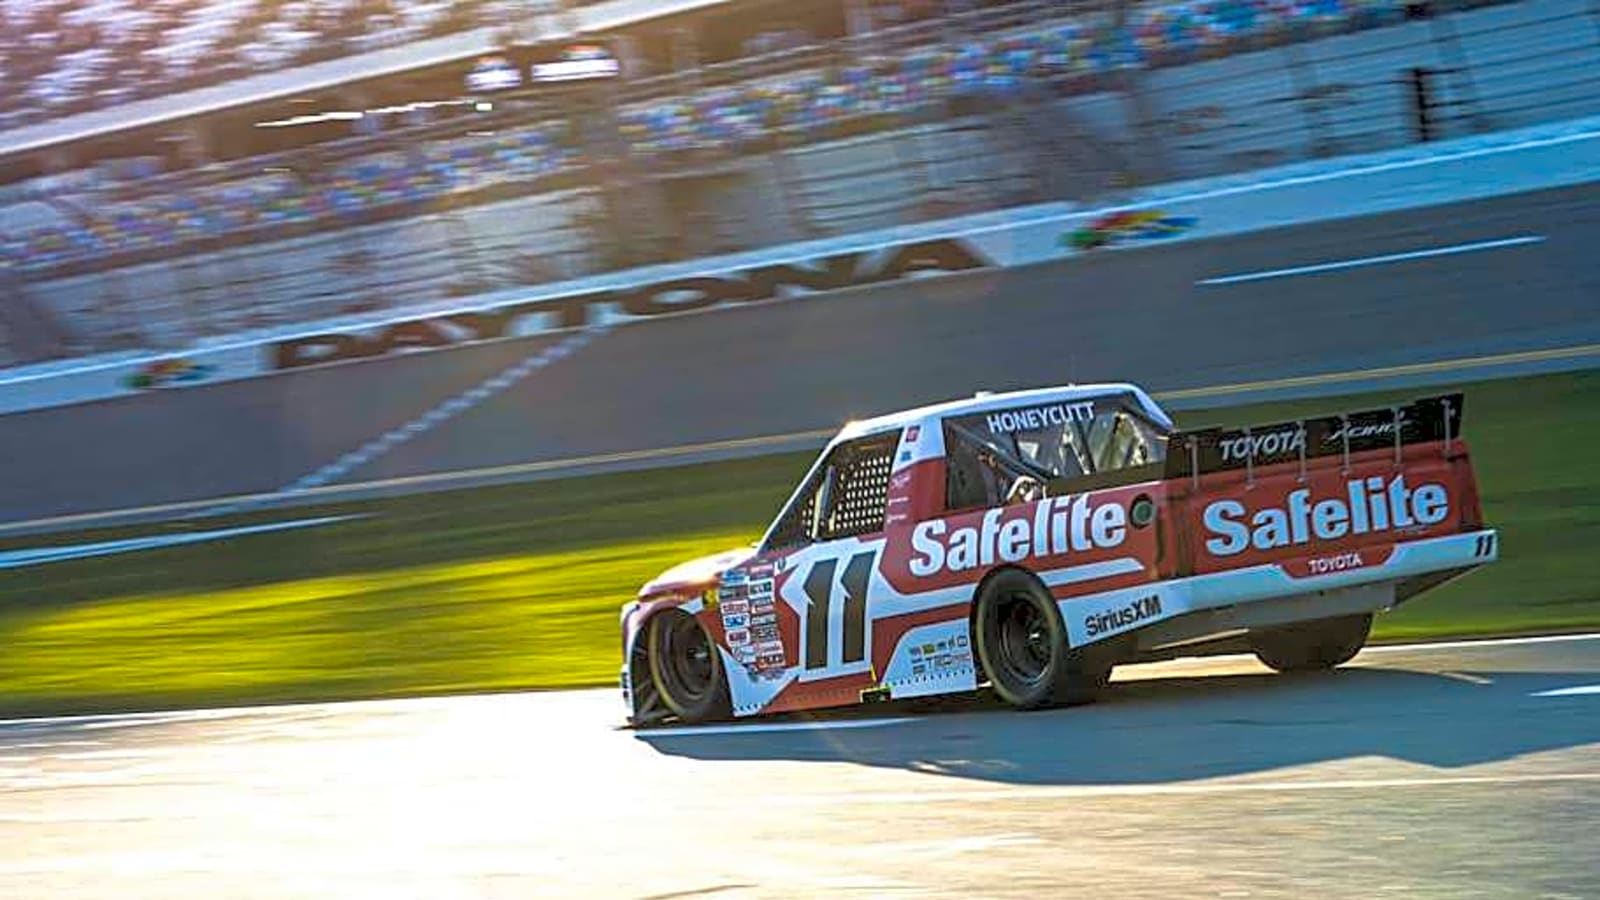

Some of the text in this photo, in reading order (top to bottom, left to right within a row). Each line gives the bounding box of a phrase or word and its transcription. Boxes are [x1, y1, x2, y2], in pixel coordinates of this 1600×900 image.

[270, 237, 993, 369] DAYTONA
[986, 402, 1096, 434] HONEYCUTT
[1219, 427, 1308, 461] TOYOTA
[909, 493, 1127, 577] Safelite
[1202, 474, 1449, 556] Safelite
[1307, 552, 1364, 575] TOYOTA
[1475, 534, 1494, 557] 11
[802, 549, 877, 671] 11
[1084, 594, 1163, 637] SiriusXM
